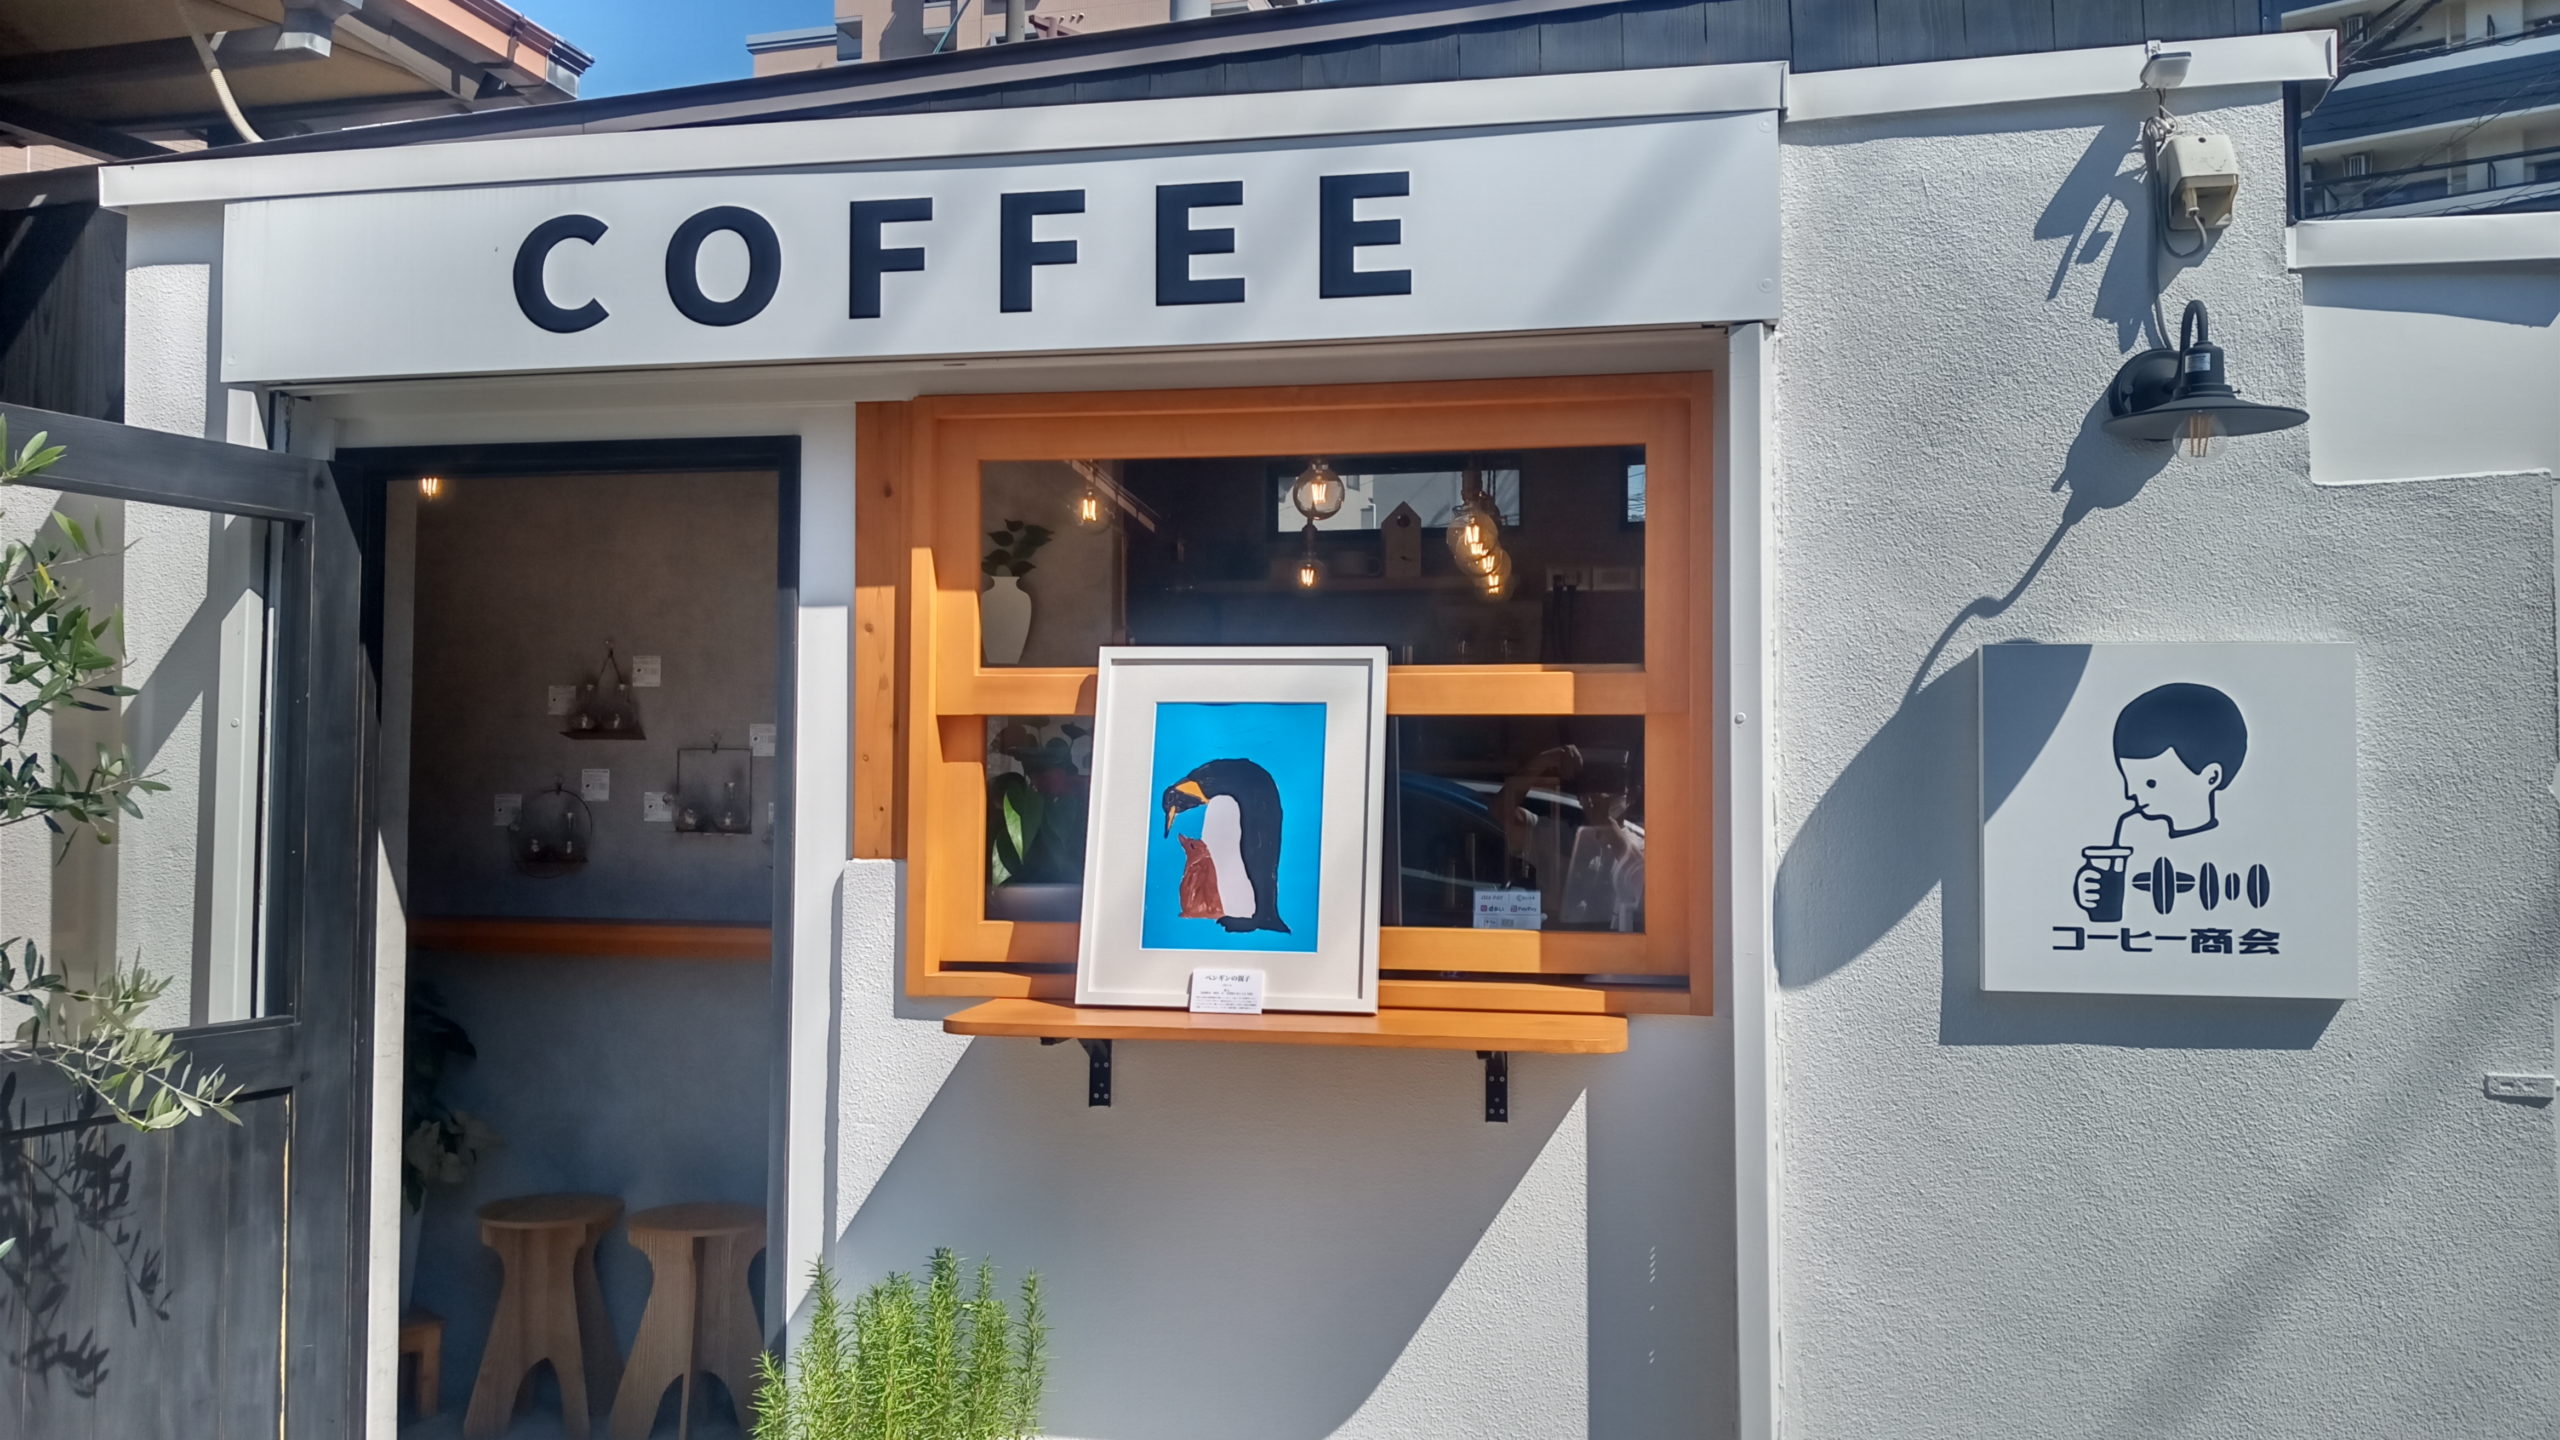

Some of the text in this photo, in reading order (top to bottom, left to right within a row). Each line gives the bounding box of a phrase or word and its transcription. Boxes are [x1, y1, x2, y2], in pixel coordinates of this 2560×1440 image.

[513, 171, 1411, 332] COFFEE
[2052, 926, 2280, 955] コーヒー商会
